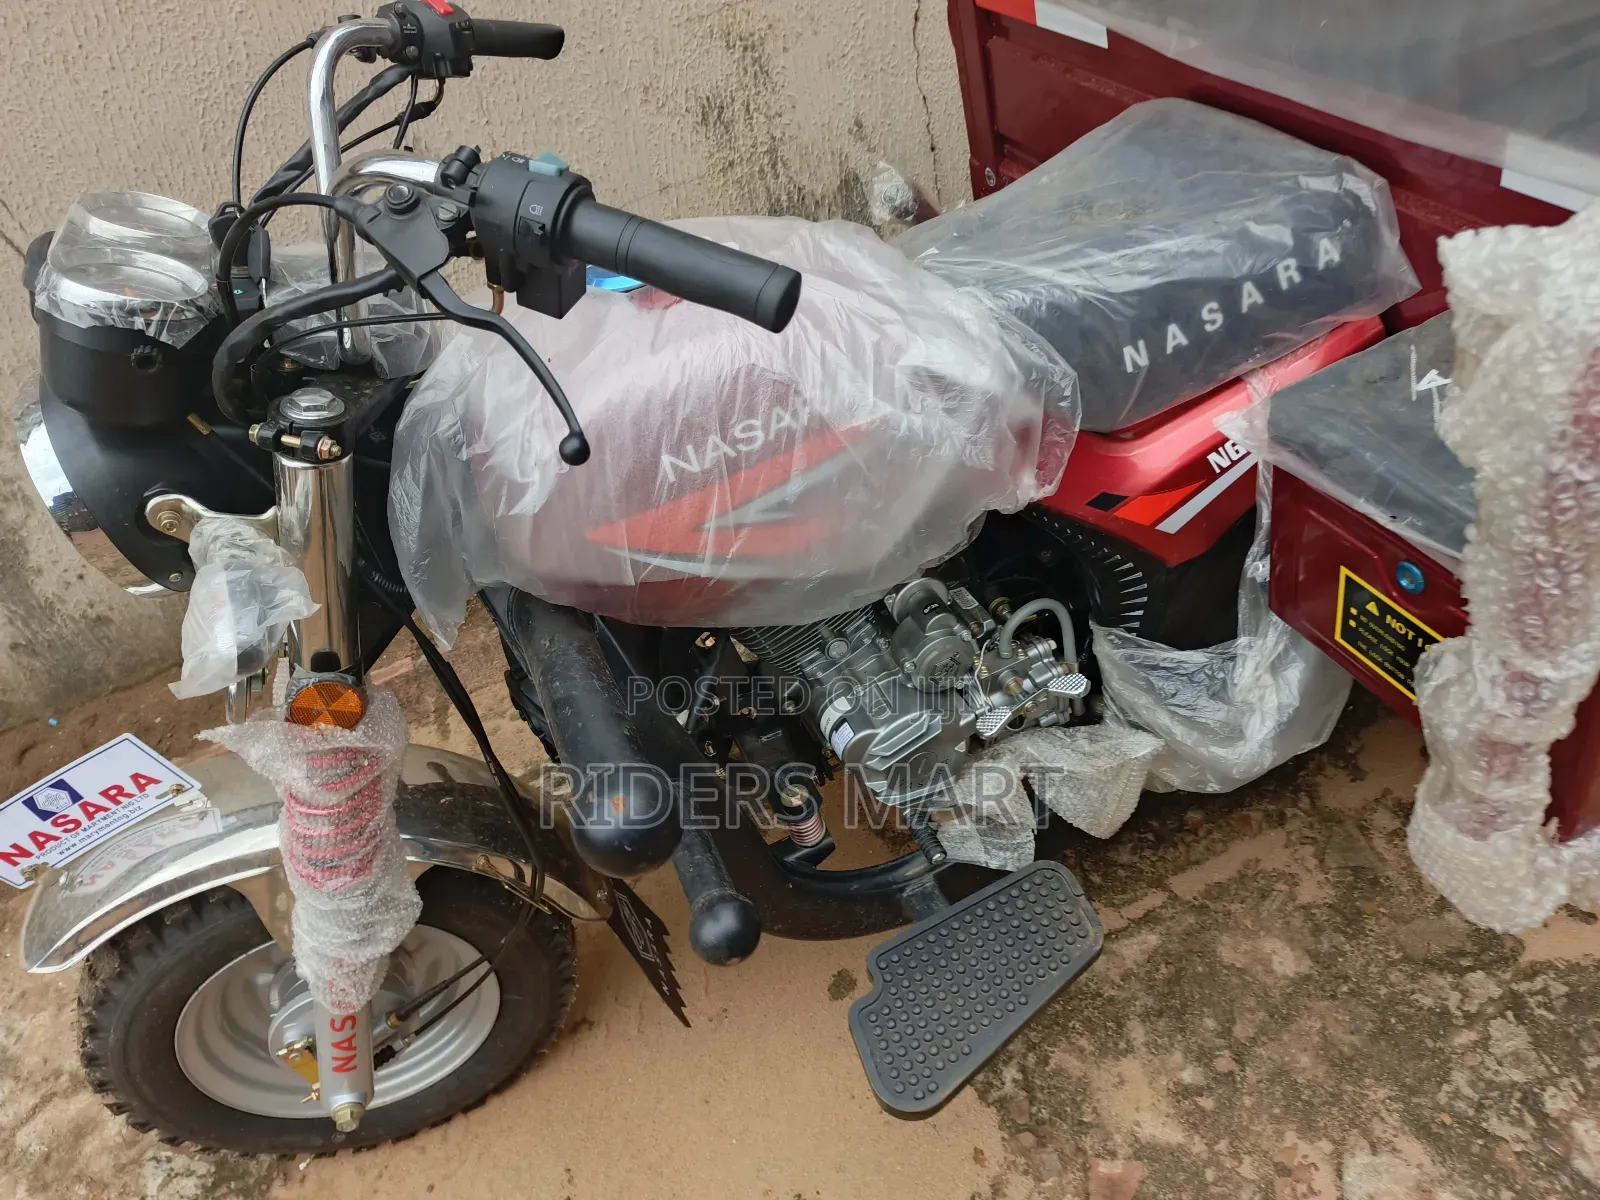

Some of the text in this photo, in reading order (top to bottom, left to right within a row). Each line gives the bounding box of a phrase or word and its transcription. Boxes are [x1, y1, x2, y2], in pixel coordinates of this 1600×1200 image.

[1122, 237, 1342, 373] NASARA
[660, 405, 797, 484] NASA
[1385, 614, 1432, 653] NOTI
[0, 772, 163, 868] NASARA
[35, 792, 150, 860] PRODUCT OF MARYMENT NIG LTD
[57, 804, 144, 857] www.marymentng.biz
[330, 1015, 357, 1073] NAS
